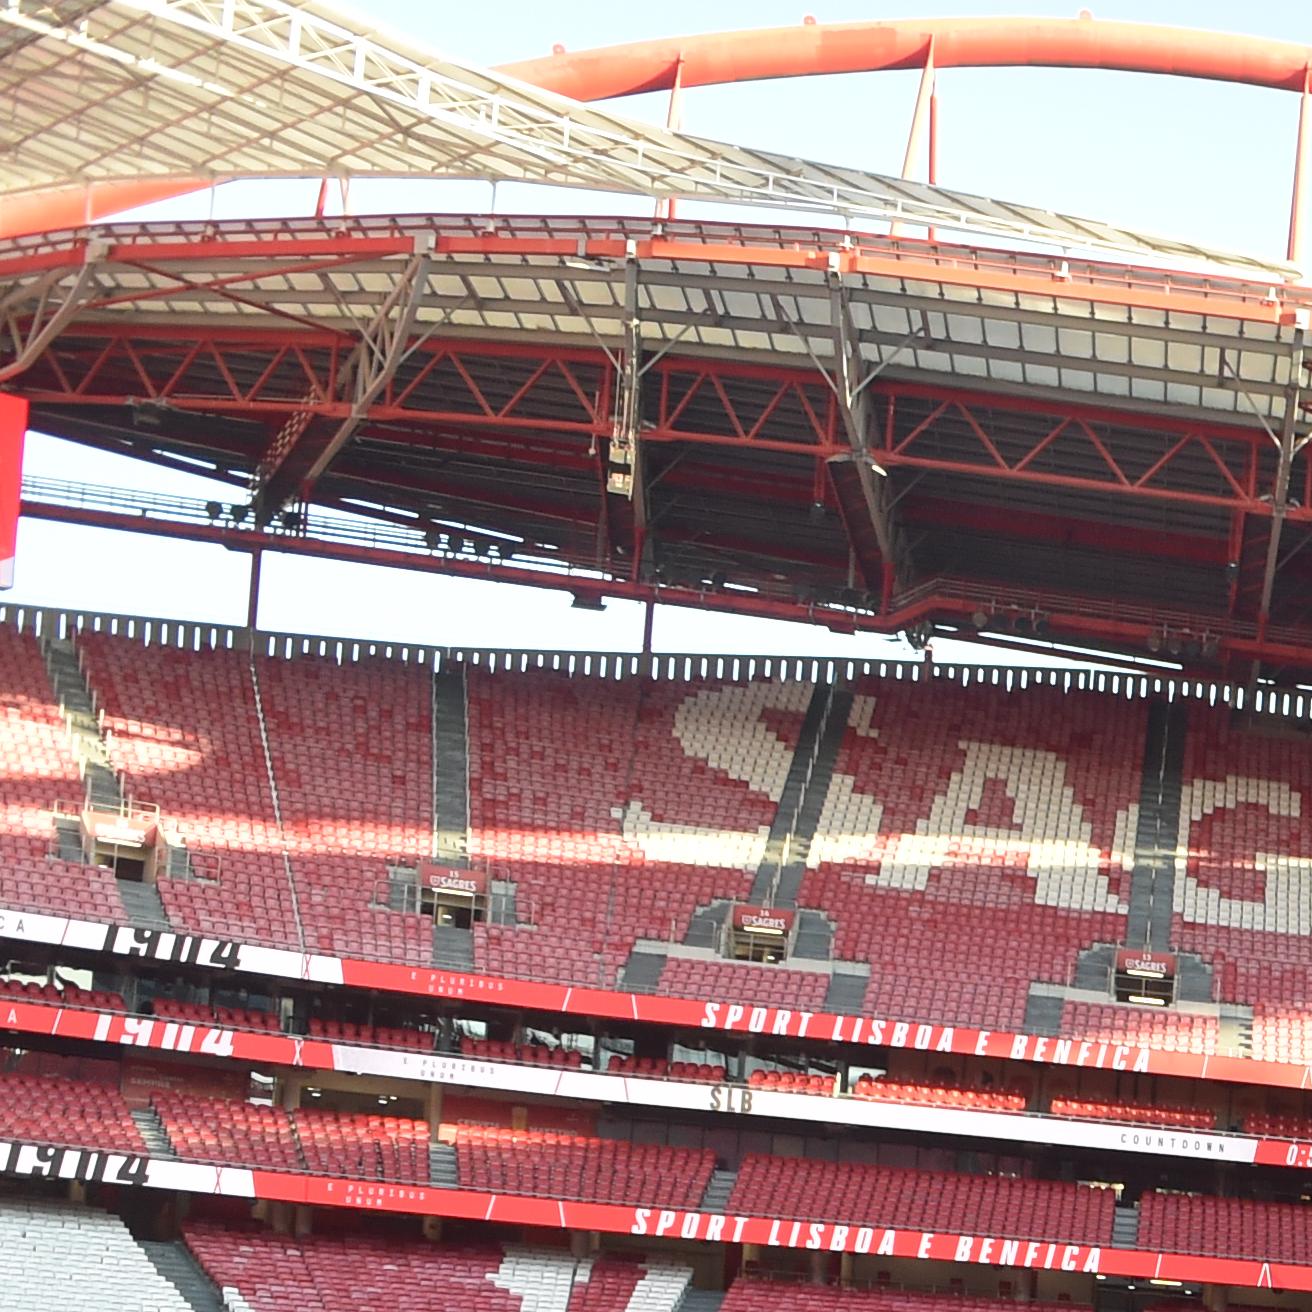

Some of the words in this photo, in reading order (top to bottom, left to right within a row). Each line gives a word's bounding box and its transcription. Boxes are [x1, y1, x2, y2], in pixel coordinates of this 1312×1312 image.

[440, 878, 477, 891] SAGRES
[751, 916, 785, 930] SAGRES
[1134, 959, 1166, 973] SAGRES
[93, 1014, 235, 1057] 1904
[701, 1002, 813, 1037] SPORT
[832, 1016, 954, 1053] LISBOA
[974, 1031, 991, 1056] E
[1010, 1034, 1150, 1073] BENFICA
[710, 1083, 753, 1114] SLB
[1120, 1134, 1225, 1153] COUNTDOWN
[631, 1208, 748, 1243] SPORT
[768, 1219, 896, 1256] LISBOA
[917, 1232, 935, 1259] E
[954, 1235, 1101, 1274] BENFICA
